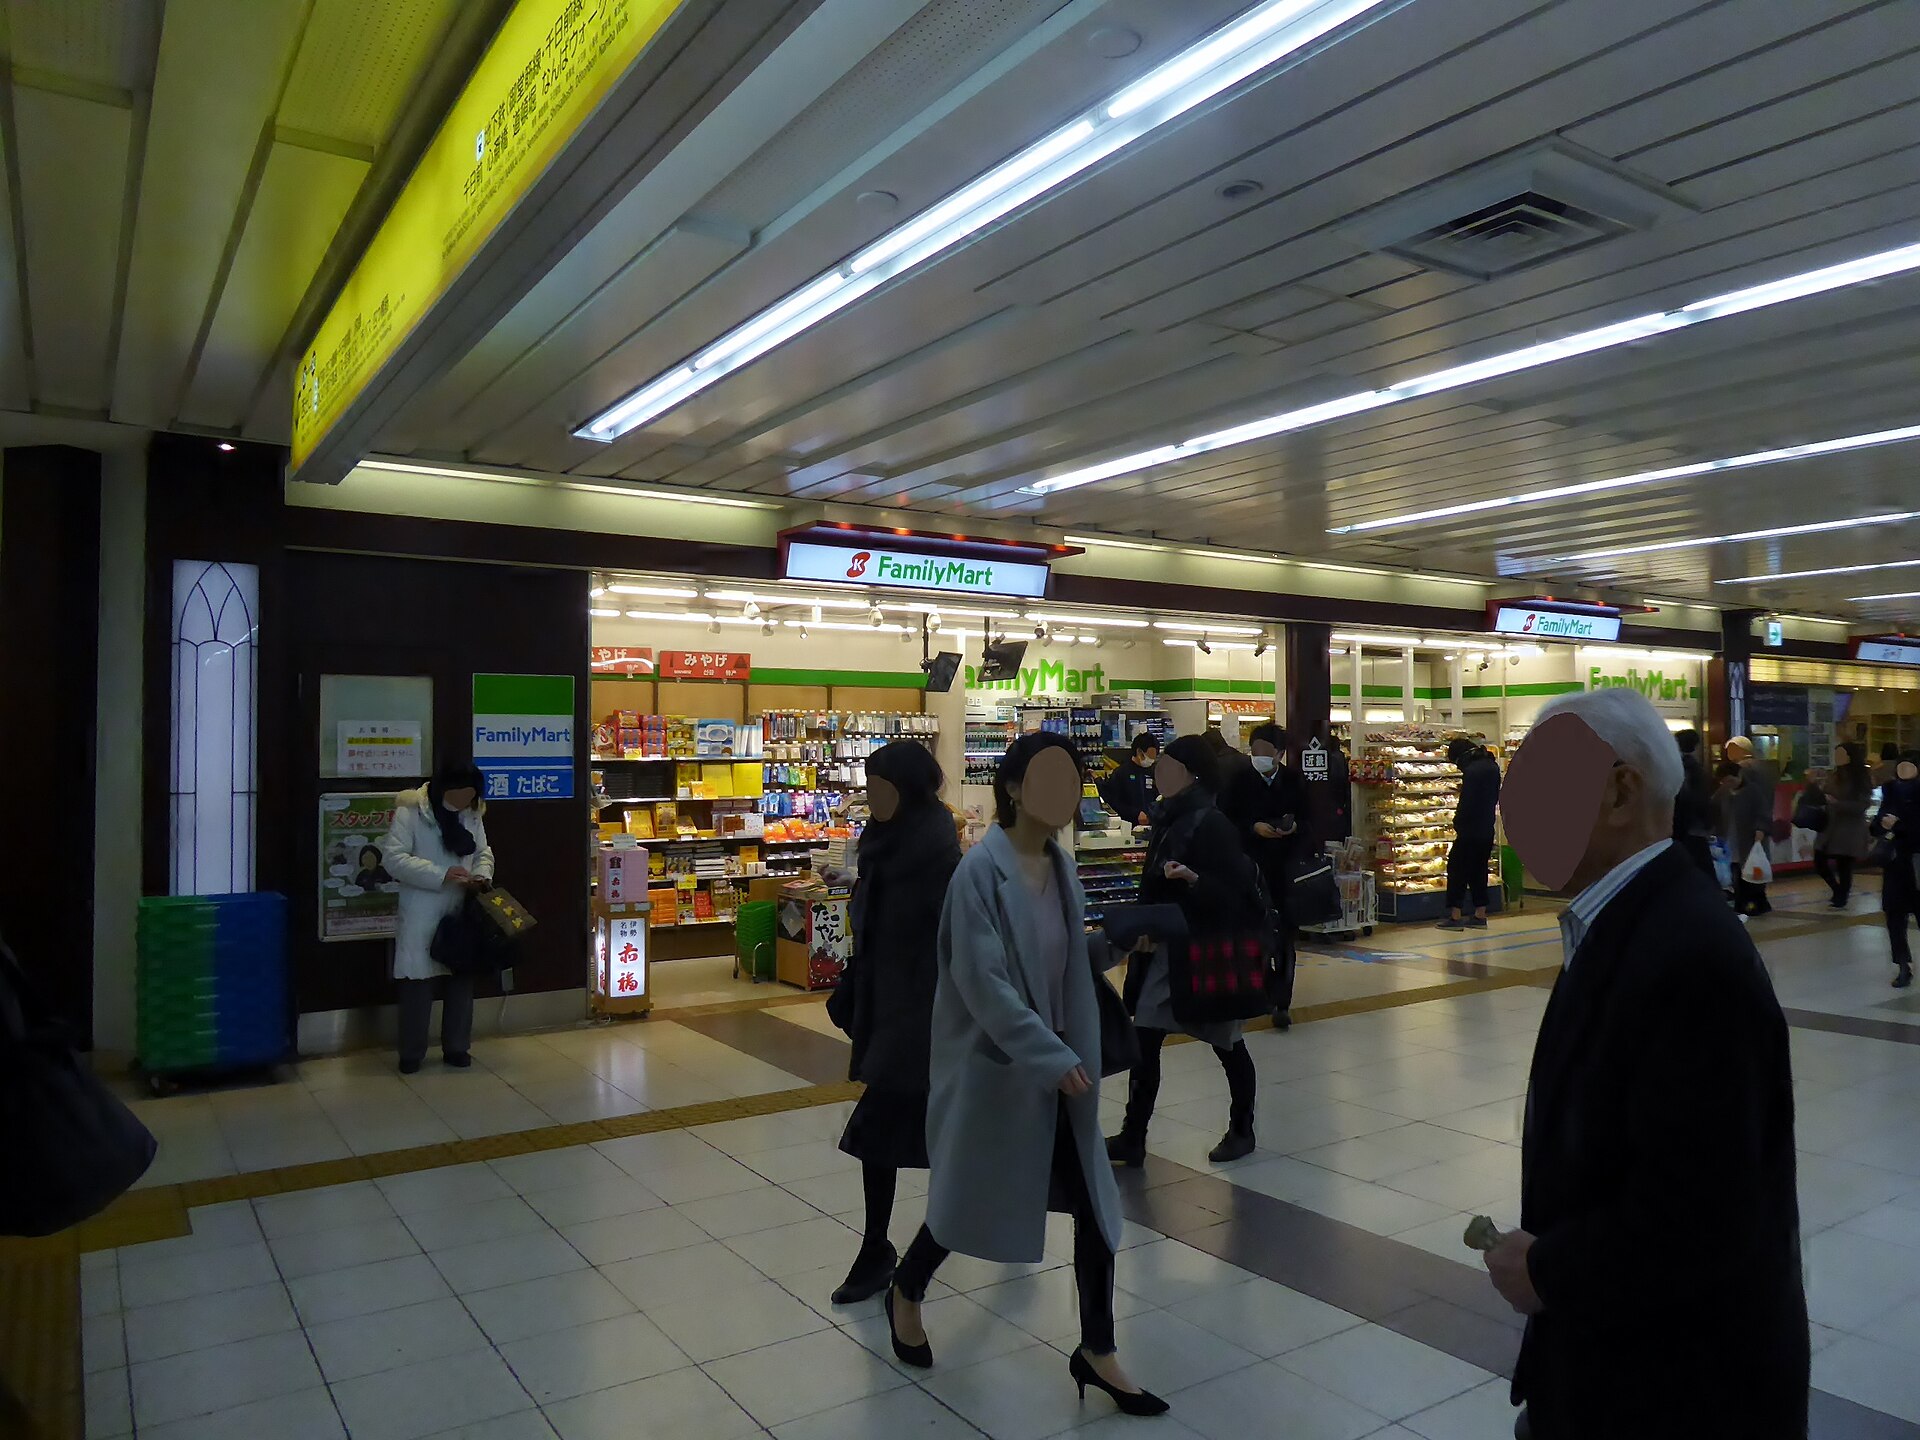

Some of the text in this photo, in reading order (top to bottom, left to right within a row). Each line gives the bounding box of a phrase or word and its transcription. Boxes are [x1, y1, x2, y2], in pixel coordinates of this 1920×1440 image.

[878, 555, 993, 586] FamilyMart
[1537, 616, 1593, 635] FamilyMart
[591, 648, 627, 662] やげ
[684, 653, 728, 667] みやげ
[475, 727, 570, 746] FamilyMart
[488, 773, 560, 796] 酒 たばこ
